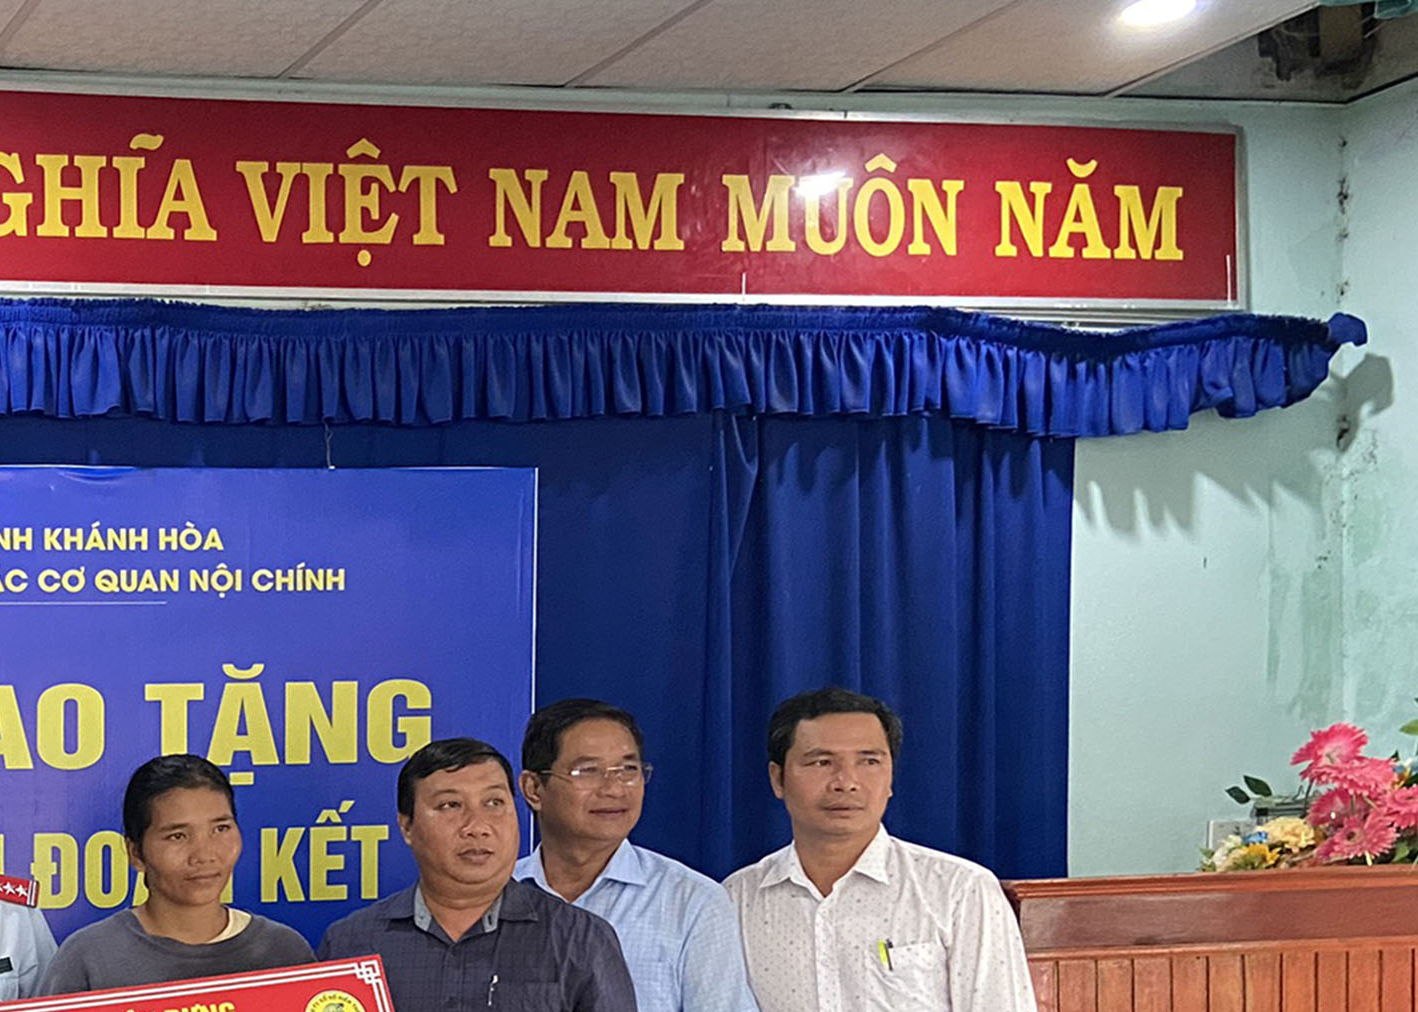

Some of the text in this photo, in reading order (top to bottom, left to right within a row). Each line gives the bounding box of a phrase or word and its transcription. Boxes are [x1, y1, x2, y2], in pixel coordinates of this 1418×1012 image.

[236, 138, 459, 267] VIỆT
[488, 167, 685, 252] NAM
[721, 154, 965, 257] MUÔN
[994, 157, 1184, 262] NĂM
[37, 565, 86, 593] CƠ
[94, 568, 180, 593] QUAN
[189, 562, 242, 599] NỘI
[251, 561, 346, 592] CHÍNH
[43, 520, 148, 551] KHÁNH
[158, 520, 224, 551] HÒA
[144, 663, 433, 785] TẶNG
[260, 800, 390, 904] KẾT
